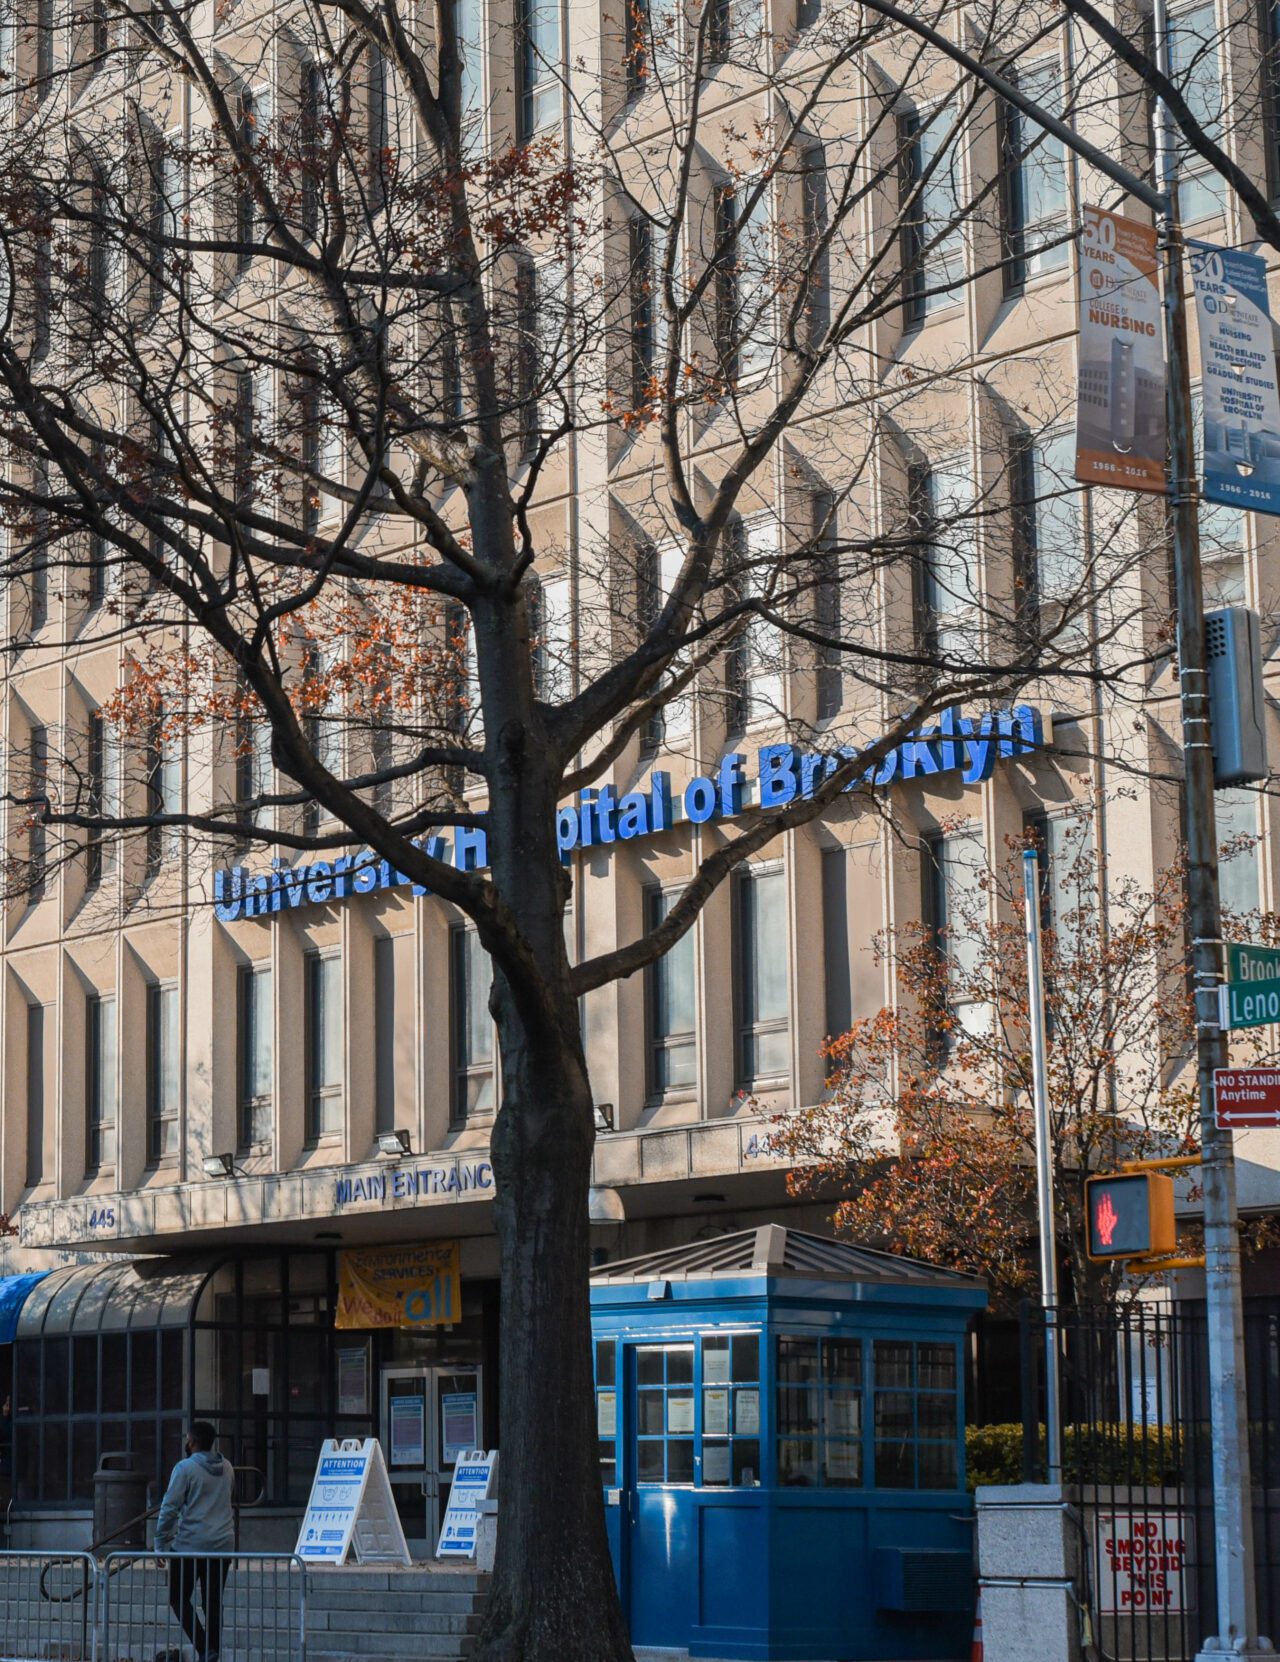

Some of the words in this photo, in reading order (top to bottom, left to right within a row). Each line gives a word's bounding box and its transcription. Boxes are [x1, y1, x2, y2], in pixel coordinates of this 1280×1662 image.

[1083, 210, 1116, 251] 50
[1084, 246, 1116, 265] YEARS
[1194, 279, 1227, 295] YEARS
[1089, 300, 1120, 315] COLLEGE
[1089, 308, 1156, 337] NURSING
[455, 771, 670, 872] Hpital
[685, 753, 746, 824] of
[1219, 1075, 1235, 1087] NO
[1238, 1074, 1280, 1086] STANDI
[1220, 1089, 1267, 1103] Anytime
[336, 1175, 386, 1205] MAIN
[392, 1163, 493, 1198] ENTRANC
[89, 1208, 115, 1229] 445
[343, 1296, 372, 1315] We
[405, 1273, 453, 1322] all
[323, 1459, 365, 1469] ATTENTION
[458, 1467, 489, 1476] ATTENTION
[1133, 1522, 1158, 1537] NO
[1105, 1539, 1186, 1555] SMOKING
[1110, 1556, 1181, 1572] BEYOND
[1121, 1590, 1173, 1606] PONT
